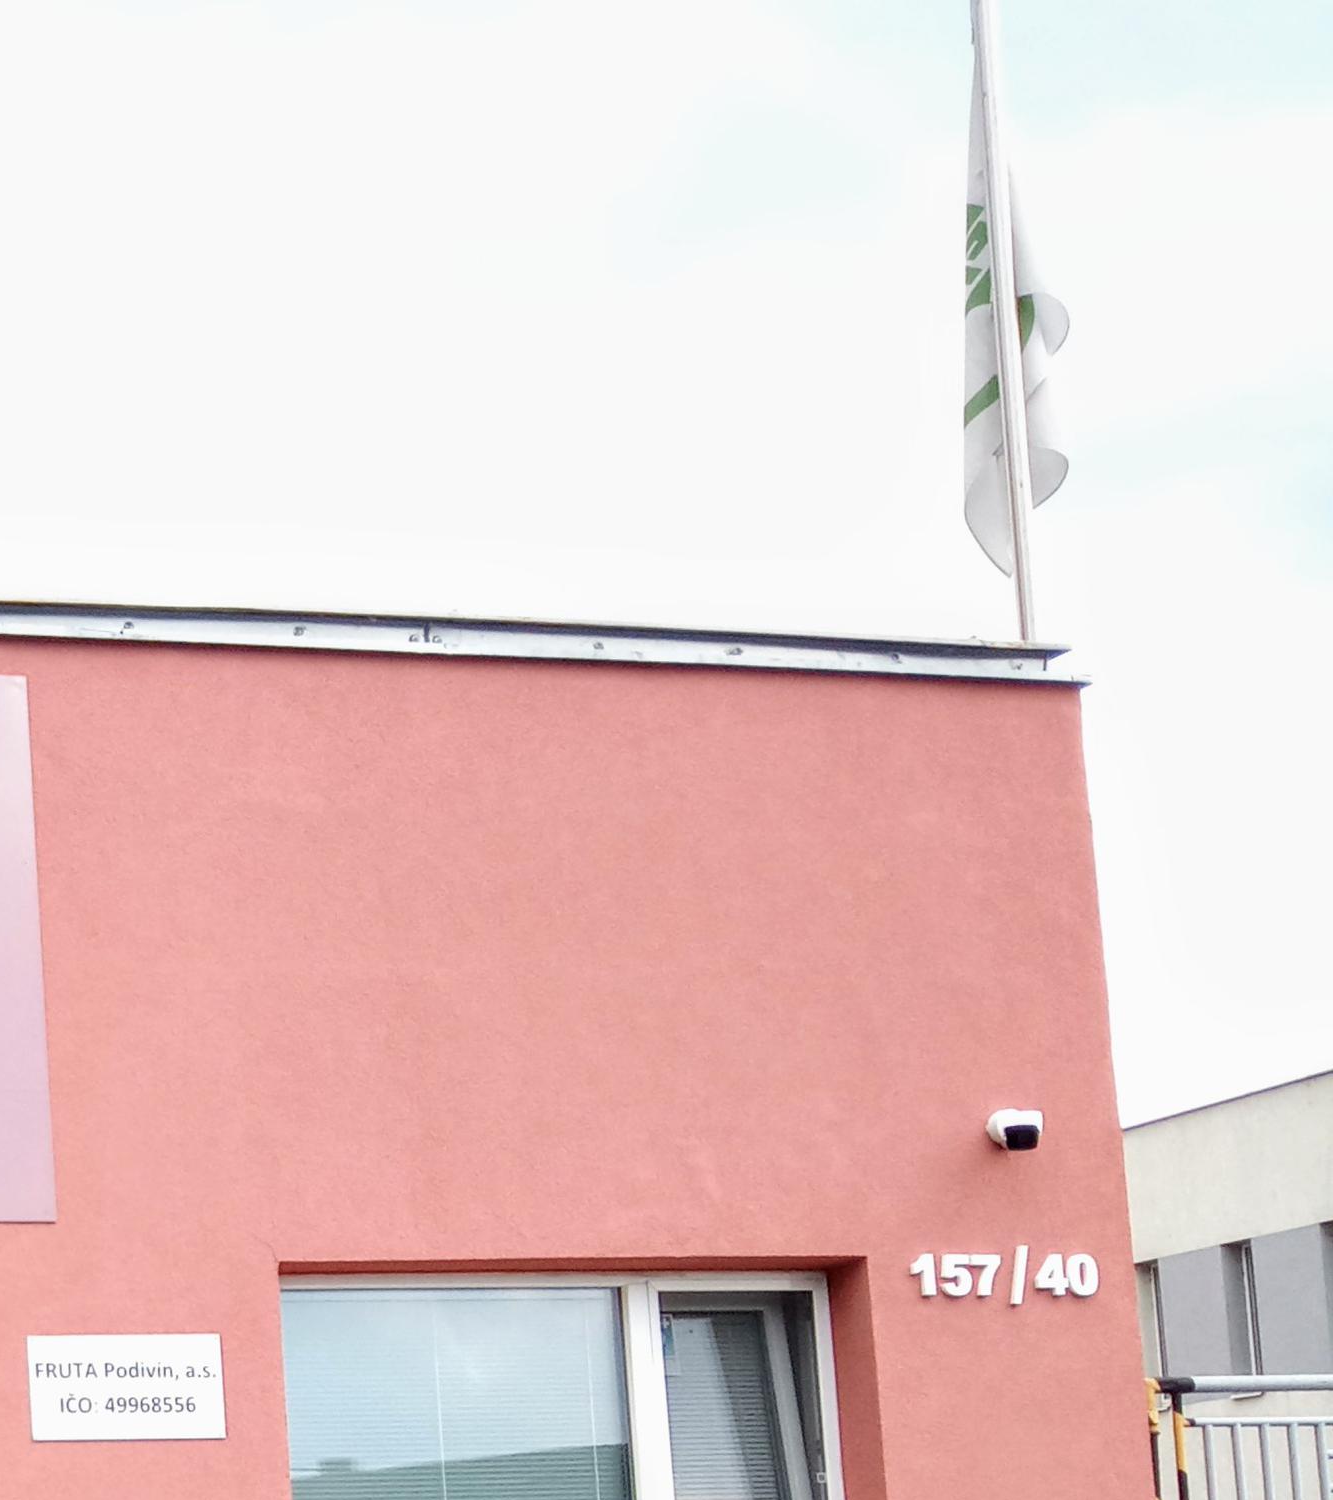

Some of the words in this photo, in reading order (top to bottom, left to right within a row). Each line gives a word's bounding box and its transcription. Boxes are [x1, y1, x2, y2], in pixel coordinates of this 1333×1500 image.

[35, 1362, 98, 1379] FRUTA
[185, 1365, 217, 1378] a.s.
[104, 1396, 197, 1413] 49968556
